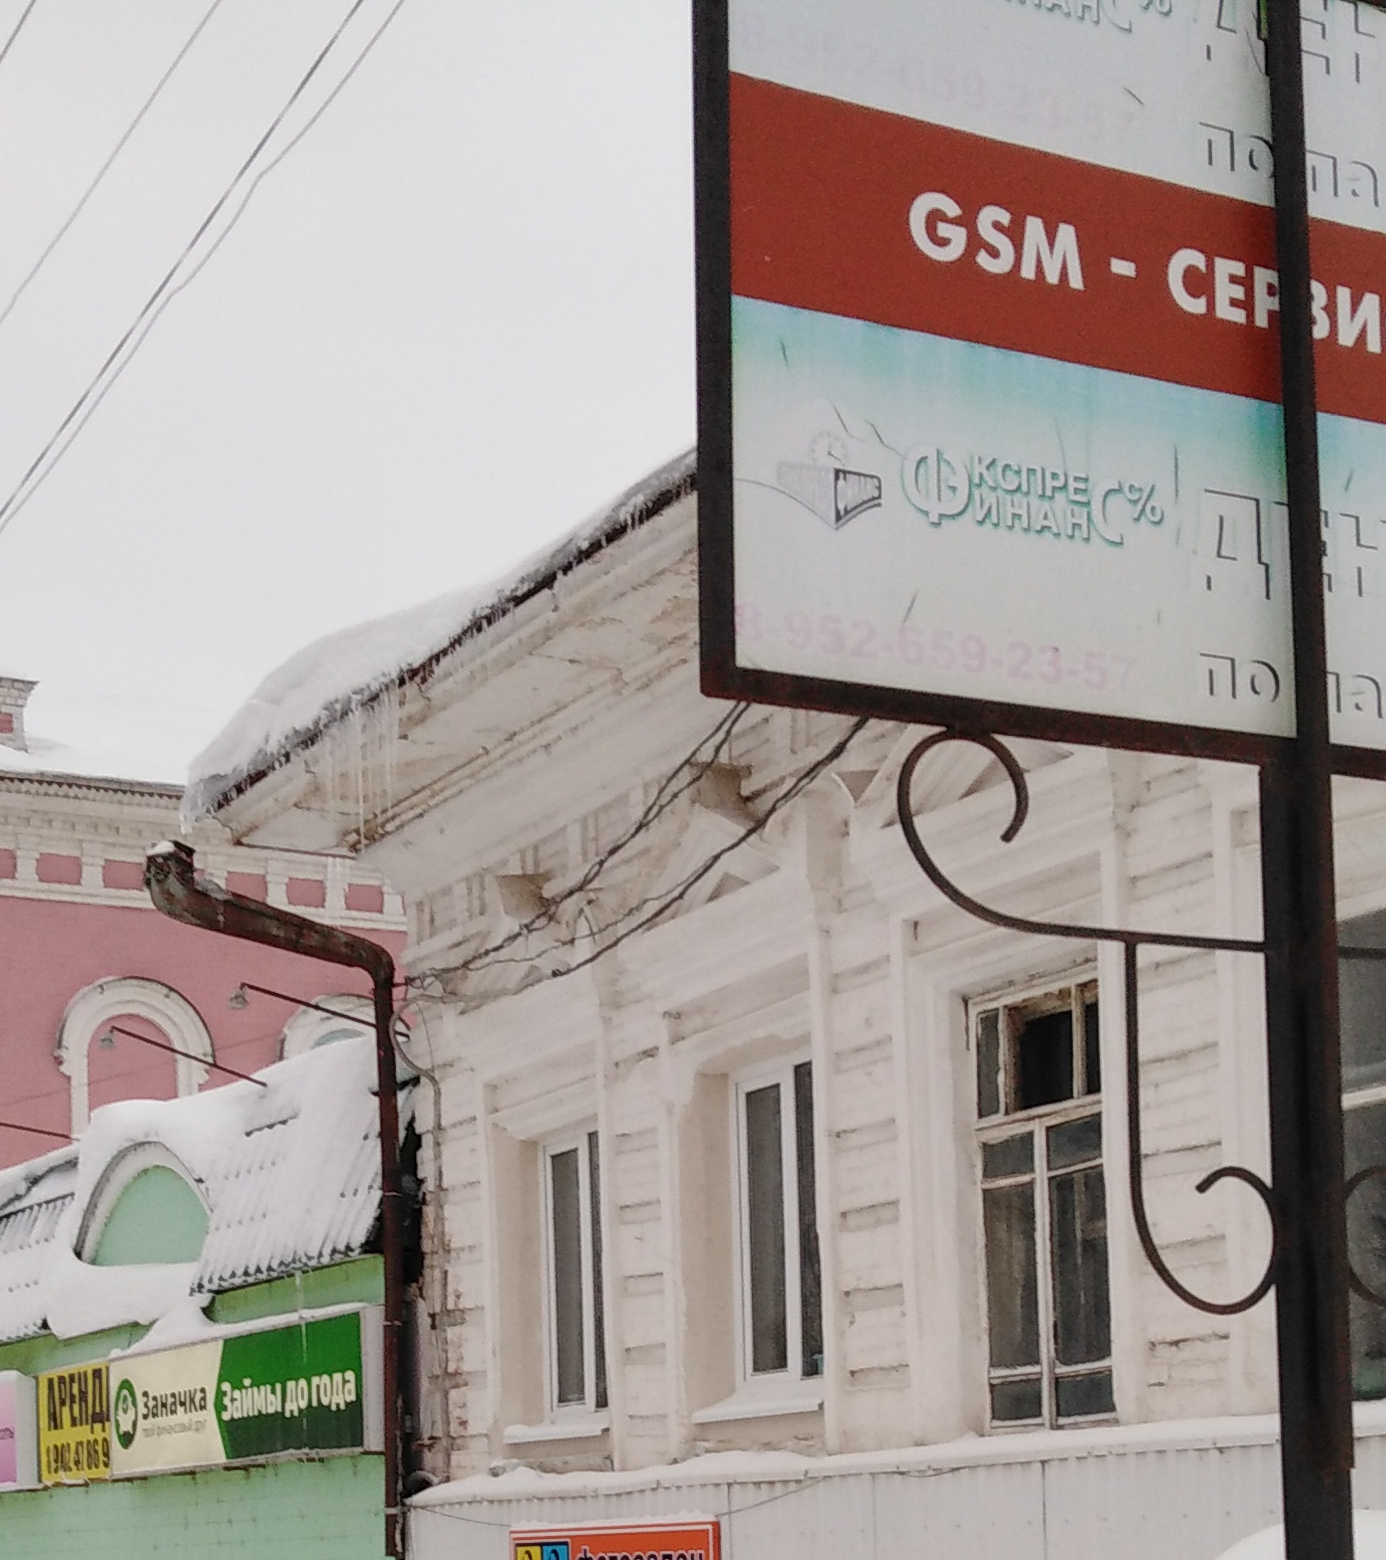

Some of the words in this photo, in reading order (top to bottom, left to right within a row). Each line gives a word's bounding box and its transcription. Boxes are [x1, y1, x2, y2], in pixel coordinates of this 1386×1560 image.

[909, 191, 1085, 292] GSM
[142, 1387, 208, 1420] Заначка
[220, 1377, 282, 1422] Займы
[284, 1377, 308, 1418] до
[311, 1369, 356, 1411] года
